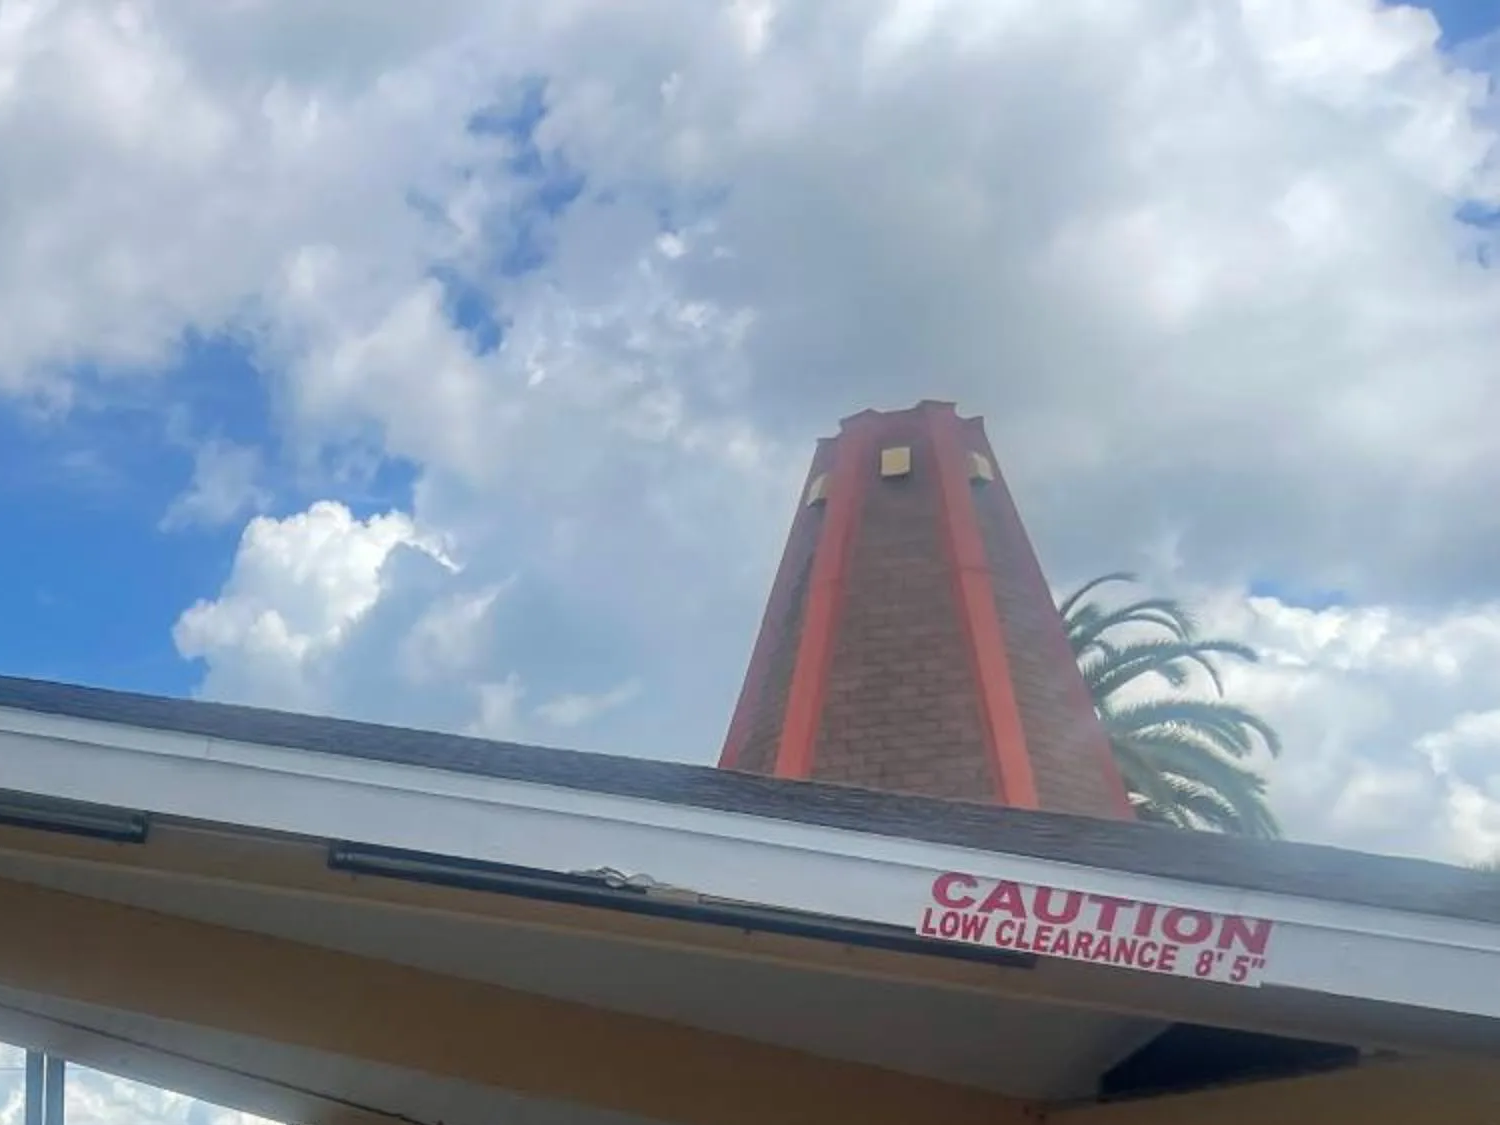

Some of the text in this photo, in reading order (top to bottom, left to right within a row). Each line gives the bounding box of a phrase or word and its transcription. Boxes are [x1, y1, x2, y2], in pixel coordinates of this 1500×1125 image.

[922, 907, 989, 942] LOW
[996, 919, 1178, 972] CLEARANCE
[932, 872, 1272, 954] CAUTION
